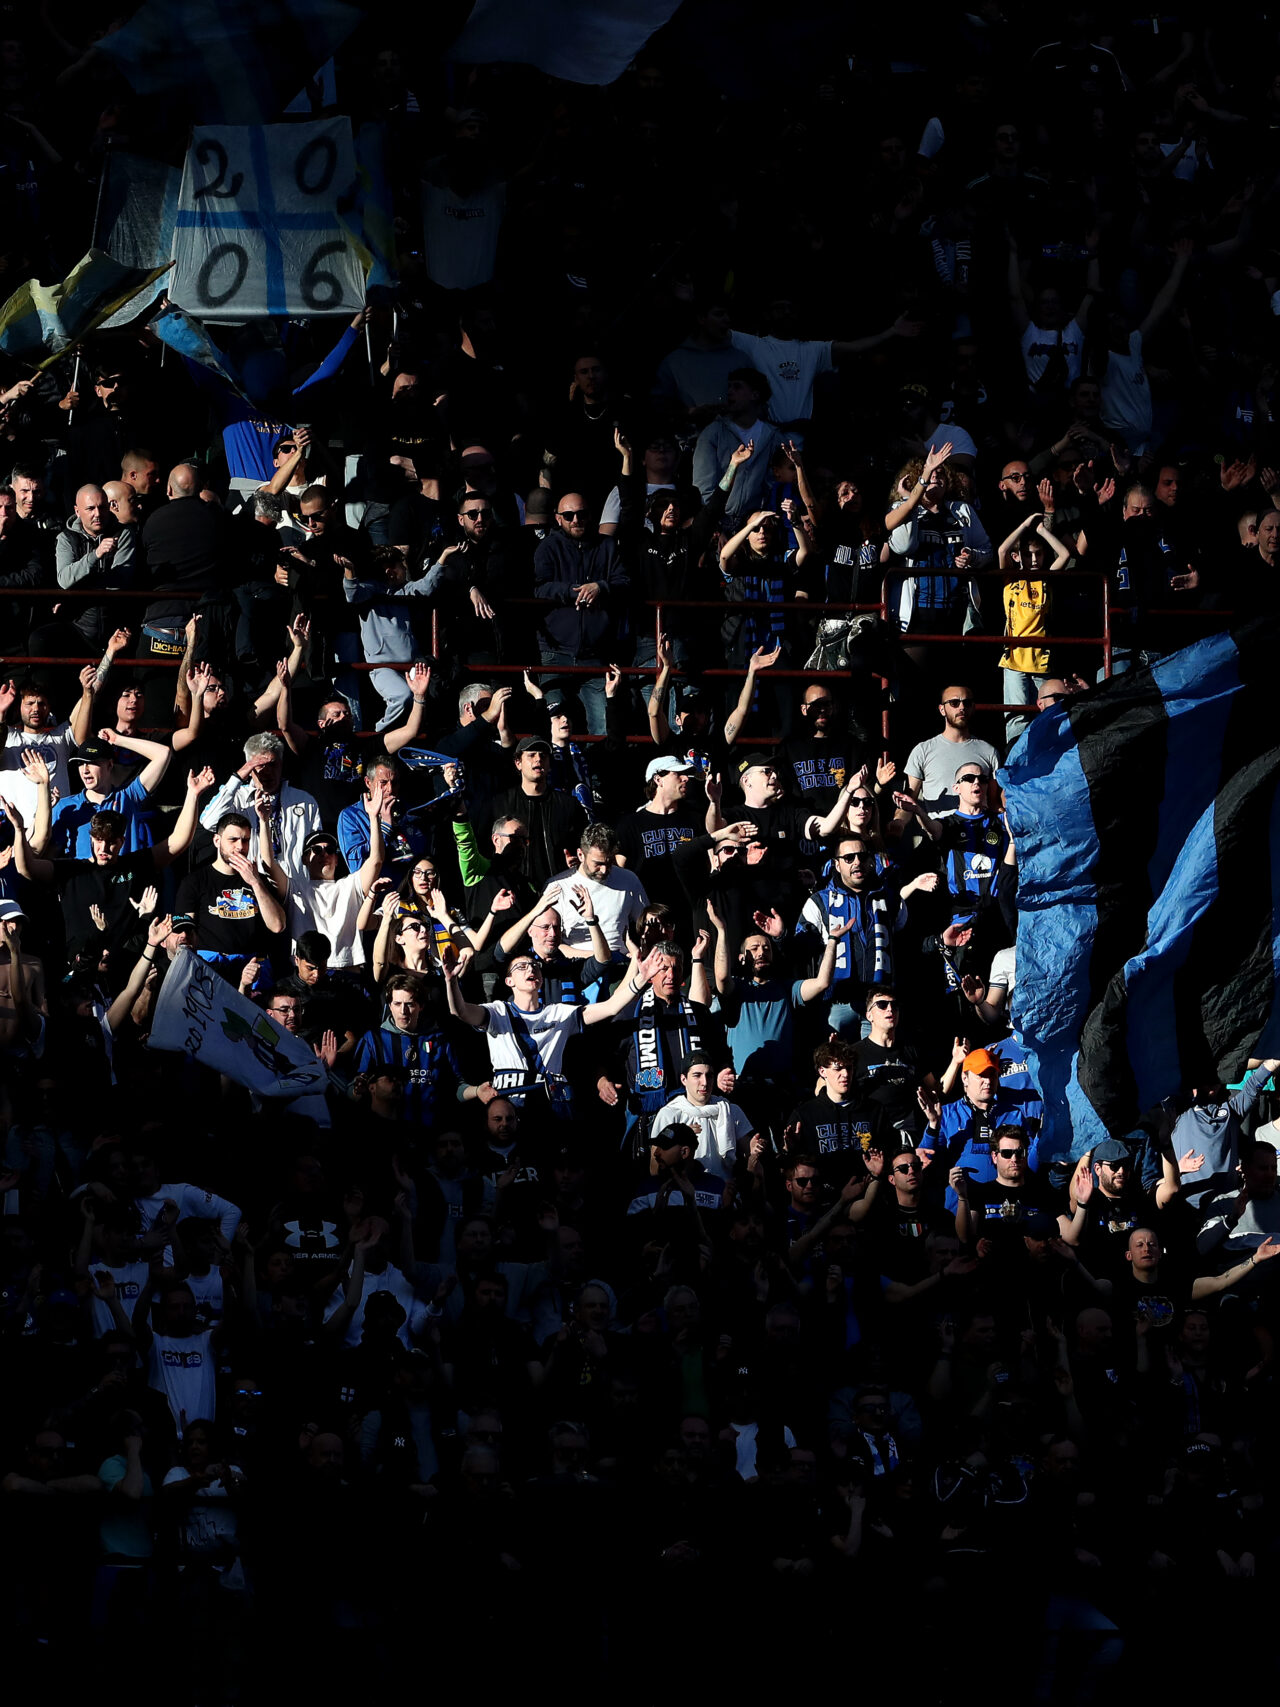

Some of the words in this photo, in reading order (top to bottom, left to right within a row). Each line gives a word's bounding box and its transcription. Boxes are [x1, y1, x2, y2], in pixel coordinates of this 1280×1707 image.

[195, 139, 243, 198] 2
[295, 136, 337, 194] 0
[197, 243, 249, 308] 0
[300, 240, 347, 310] 6
[184, 964, 216, 1022] 1908
